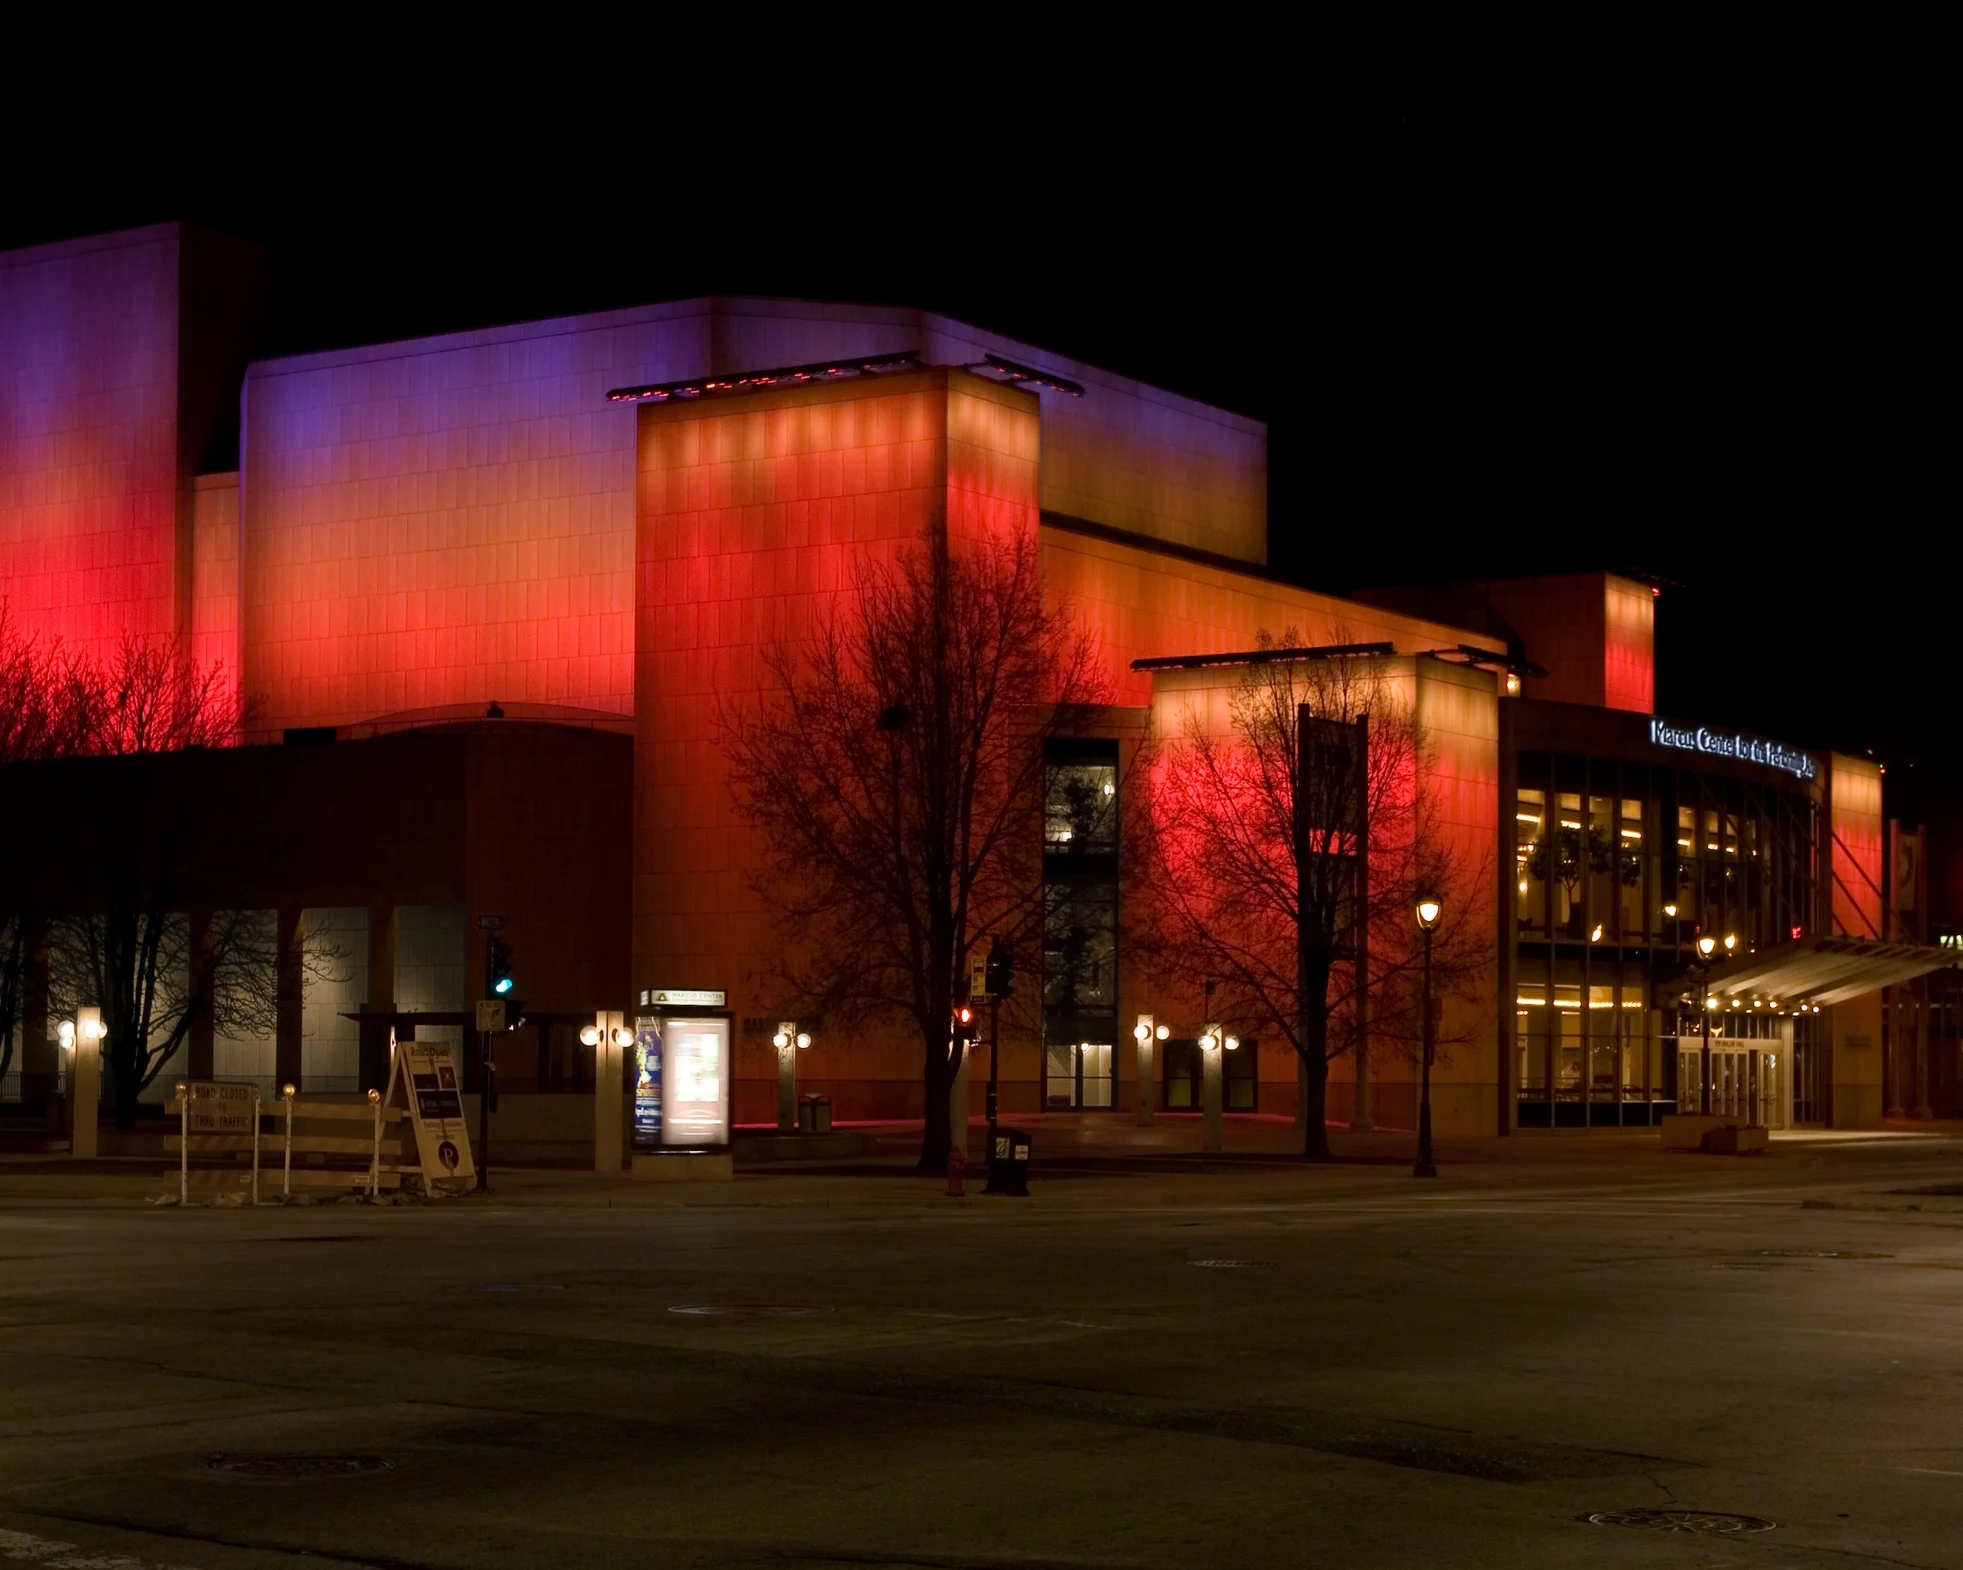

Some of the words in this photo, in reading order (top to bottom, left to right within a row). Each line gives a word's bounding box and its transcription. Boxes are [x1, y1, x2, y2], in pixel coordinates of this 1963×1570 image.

[1651, 719, 1694, 749] Marcus
[428, 1046, 449, 1059] Open
[195, 1086, 216, 1099] ROAD
[220, 1087, 248, 1101] CLOSED
[195, 1114, 215, 1128] THRU
[219, 1115, 249, 1128] TRAFFIC
[443, 1147, 454, 1165] P
